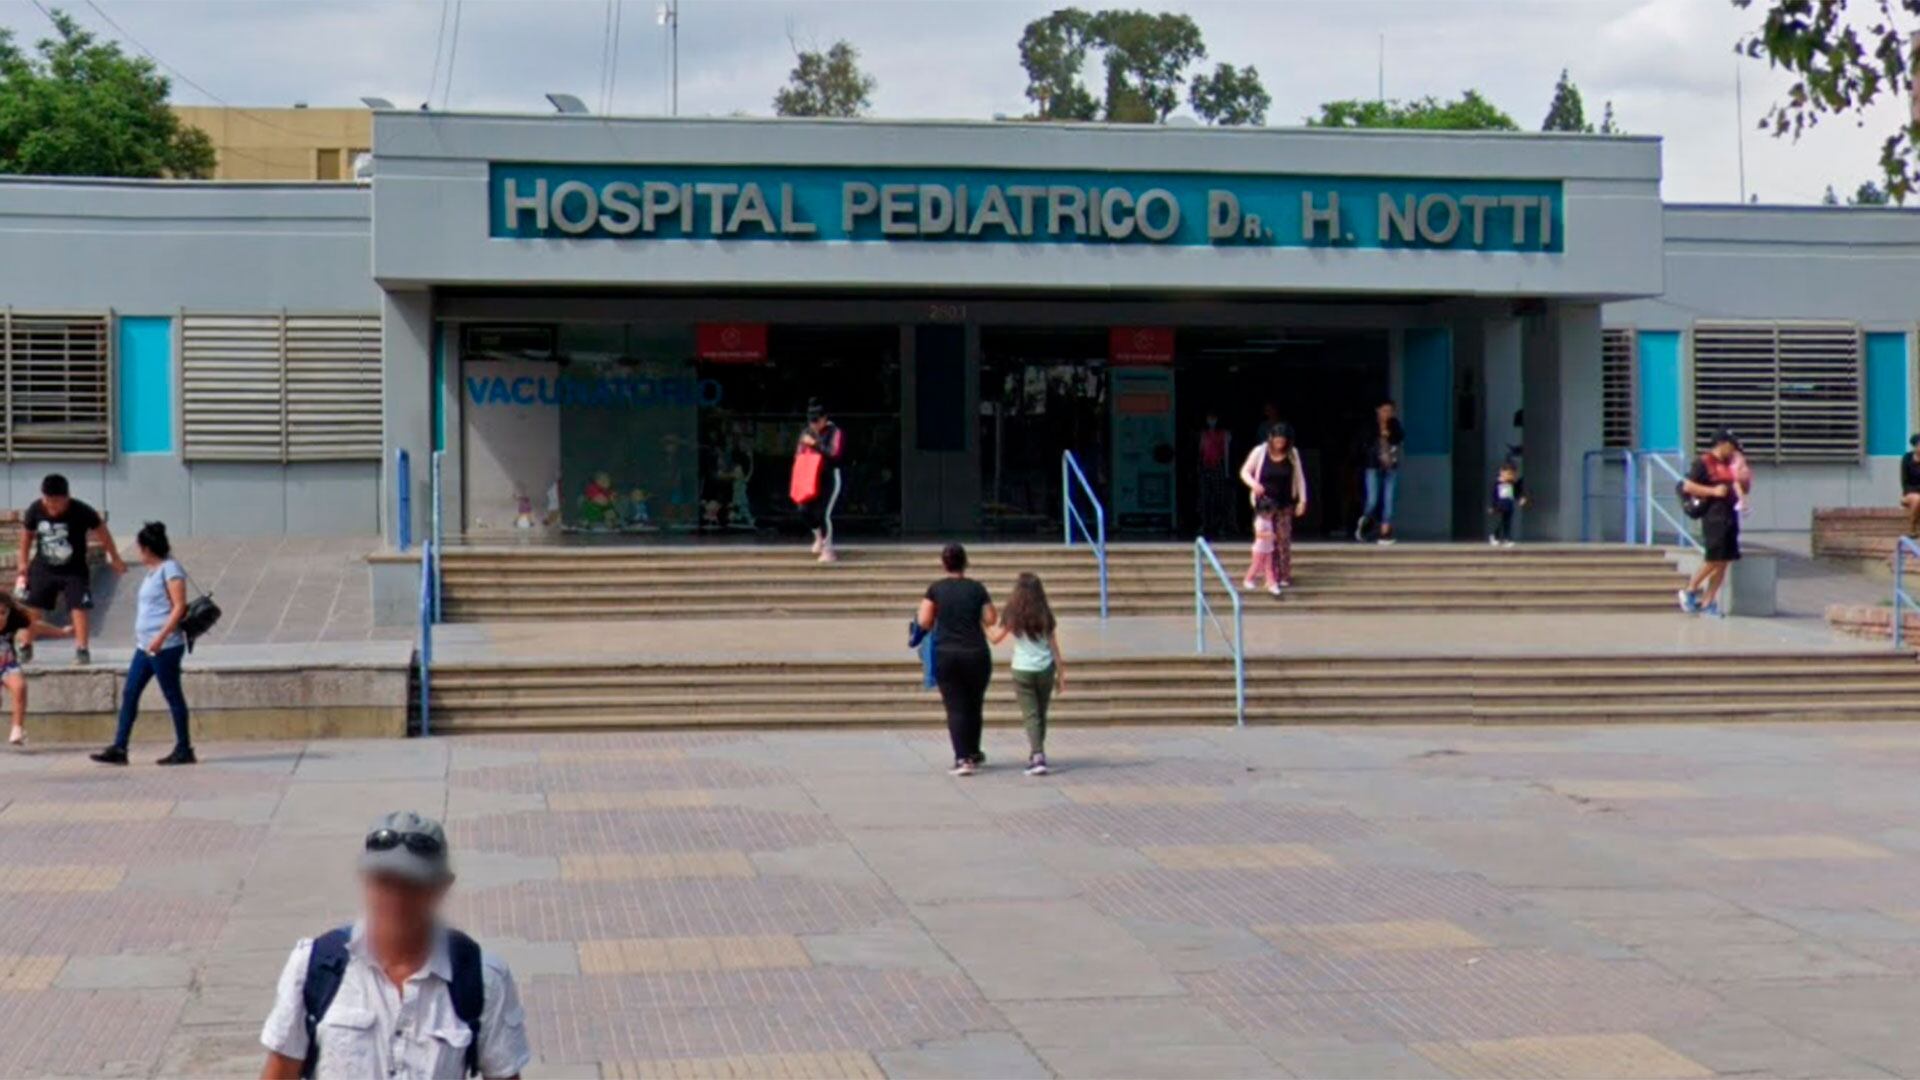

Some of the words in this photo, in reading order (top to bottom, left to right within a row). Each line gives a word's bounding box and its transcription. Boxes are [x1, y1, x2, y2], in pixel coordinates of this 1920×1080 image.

[504, 178, 816, 235] HOSPITAL
[843, 182, 1180, 241] PEDIATRICO
[1302, 191, 1355, 241] H.
[1379, 194, 1553, 246] NOTTI
[466, 376, 722, 407] VACUNATORIO
